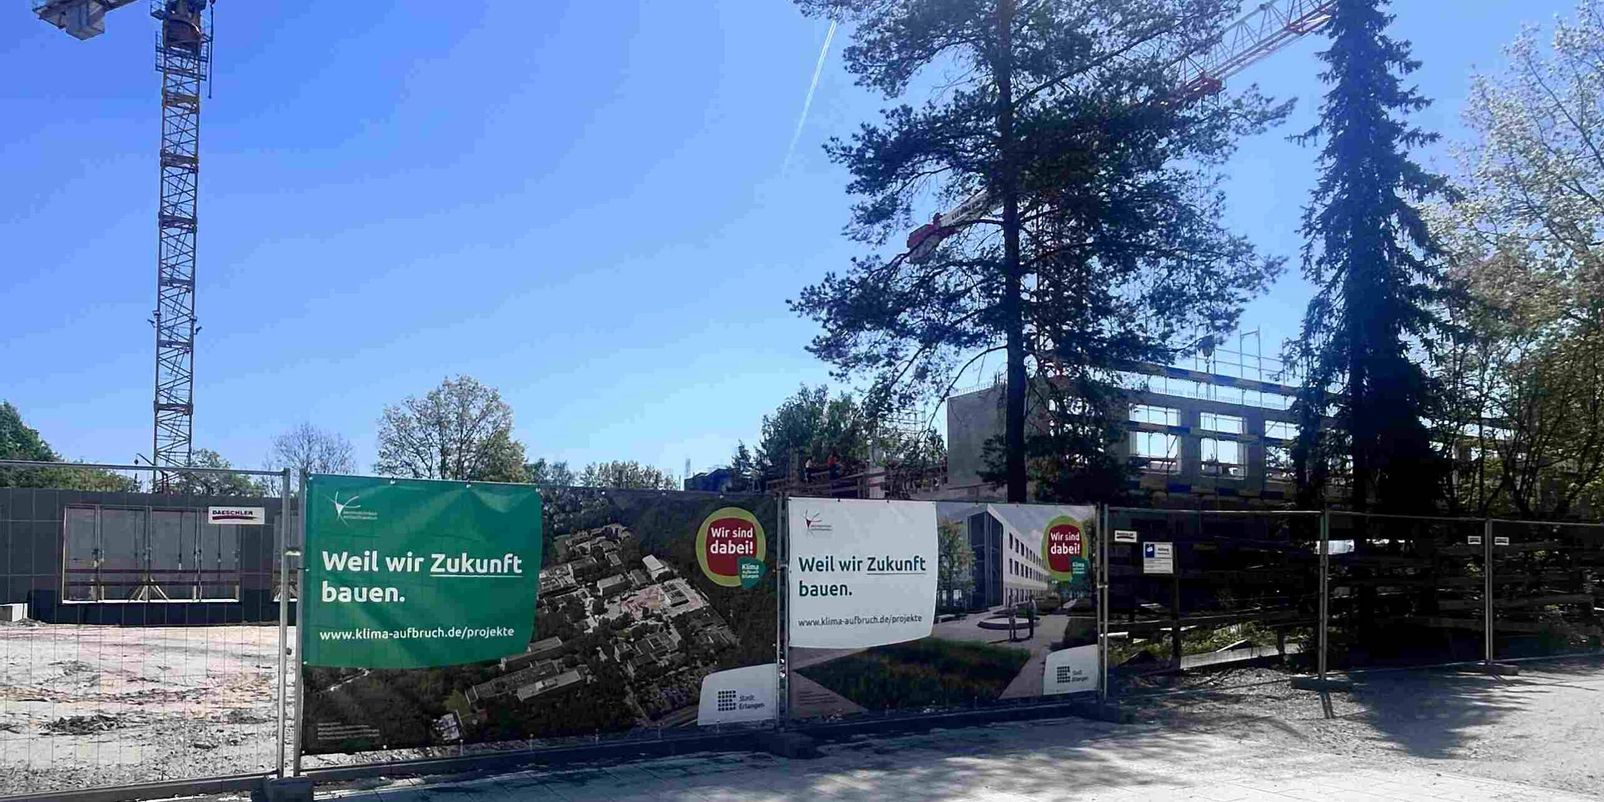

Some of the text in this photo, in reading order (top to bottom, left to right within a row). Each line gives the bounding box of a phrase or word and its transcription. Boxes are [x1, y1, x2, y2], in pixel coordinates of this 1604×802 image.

[710, 526, 754, 538] Wir sind
[1050, 531, 1080, 541] Wir sind
[710, 540, 754, 554] dabei!
[1050, 542, 1081, 555] dabei!
[321, 550, 523, 574] Weil wir Zukunft
[798, 555, 927, 572] Weil wir Zukunft
[321, 580, 406, 603] bauen.
[799, 580, 853, 597] bauen.
[797, 613, 923, 627] www.klima-aufbruch.de/projekte
[319, 626, 515, 641] www.klima-aufbruch.de/projekte
[739, 702, 766, 710] Erlangen
